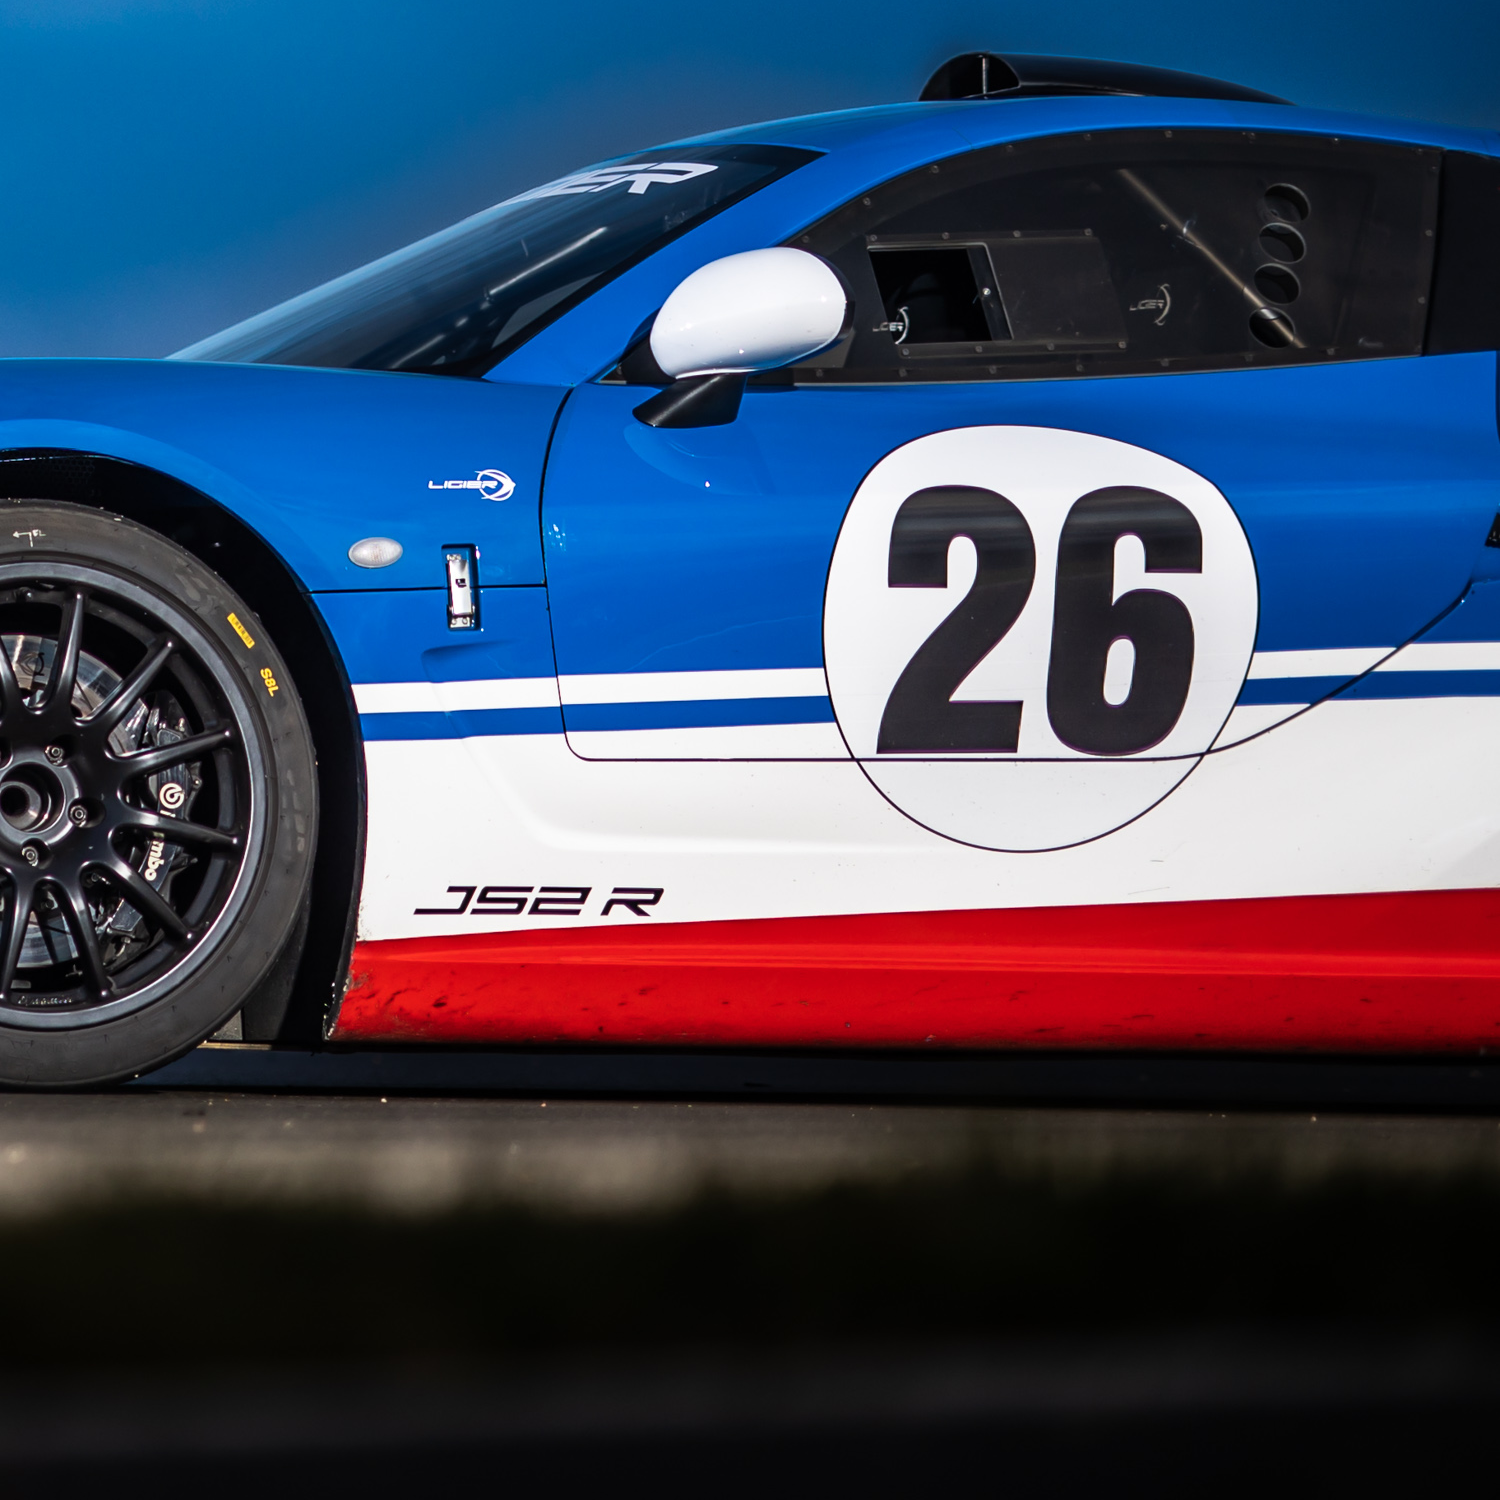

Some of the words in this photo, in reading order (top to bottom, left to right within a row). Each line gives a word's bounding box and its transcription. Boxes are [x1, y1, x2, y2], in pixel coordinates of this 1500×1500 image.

[428, 480, 498, 489] LIGIER
[876, 484, 1203, 757] 26
[260, 667, 279, 697] S8L
[413, 885, 592, 915] JS2
[600, 887, 664, 917] R
